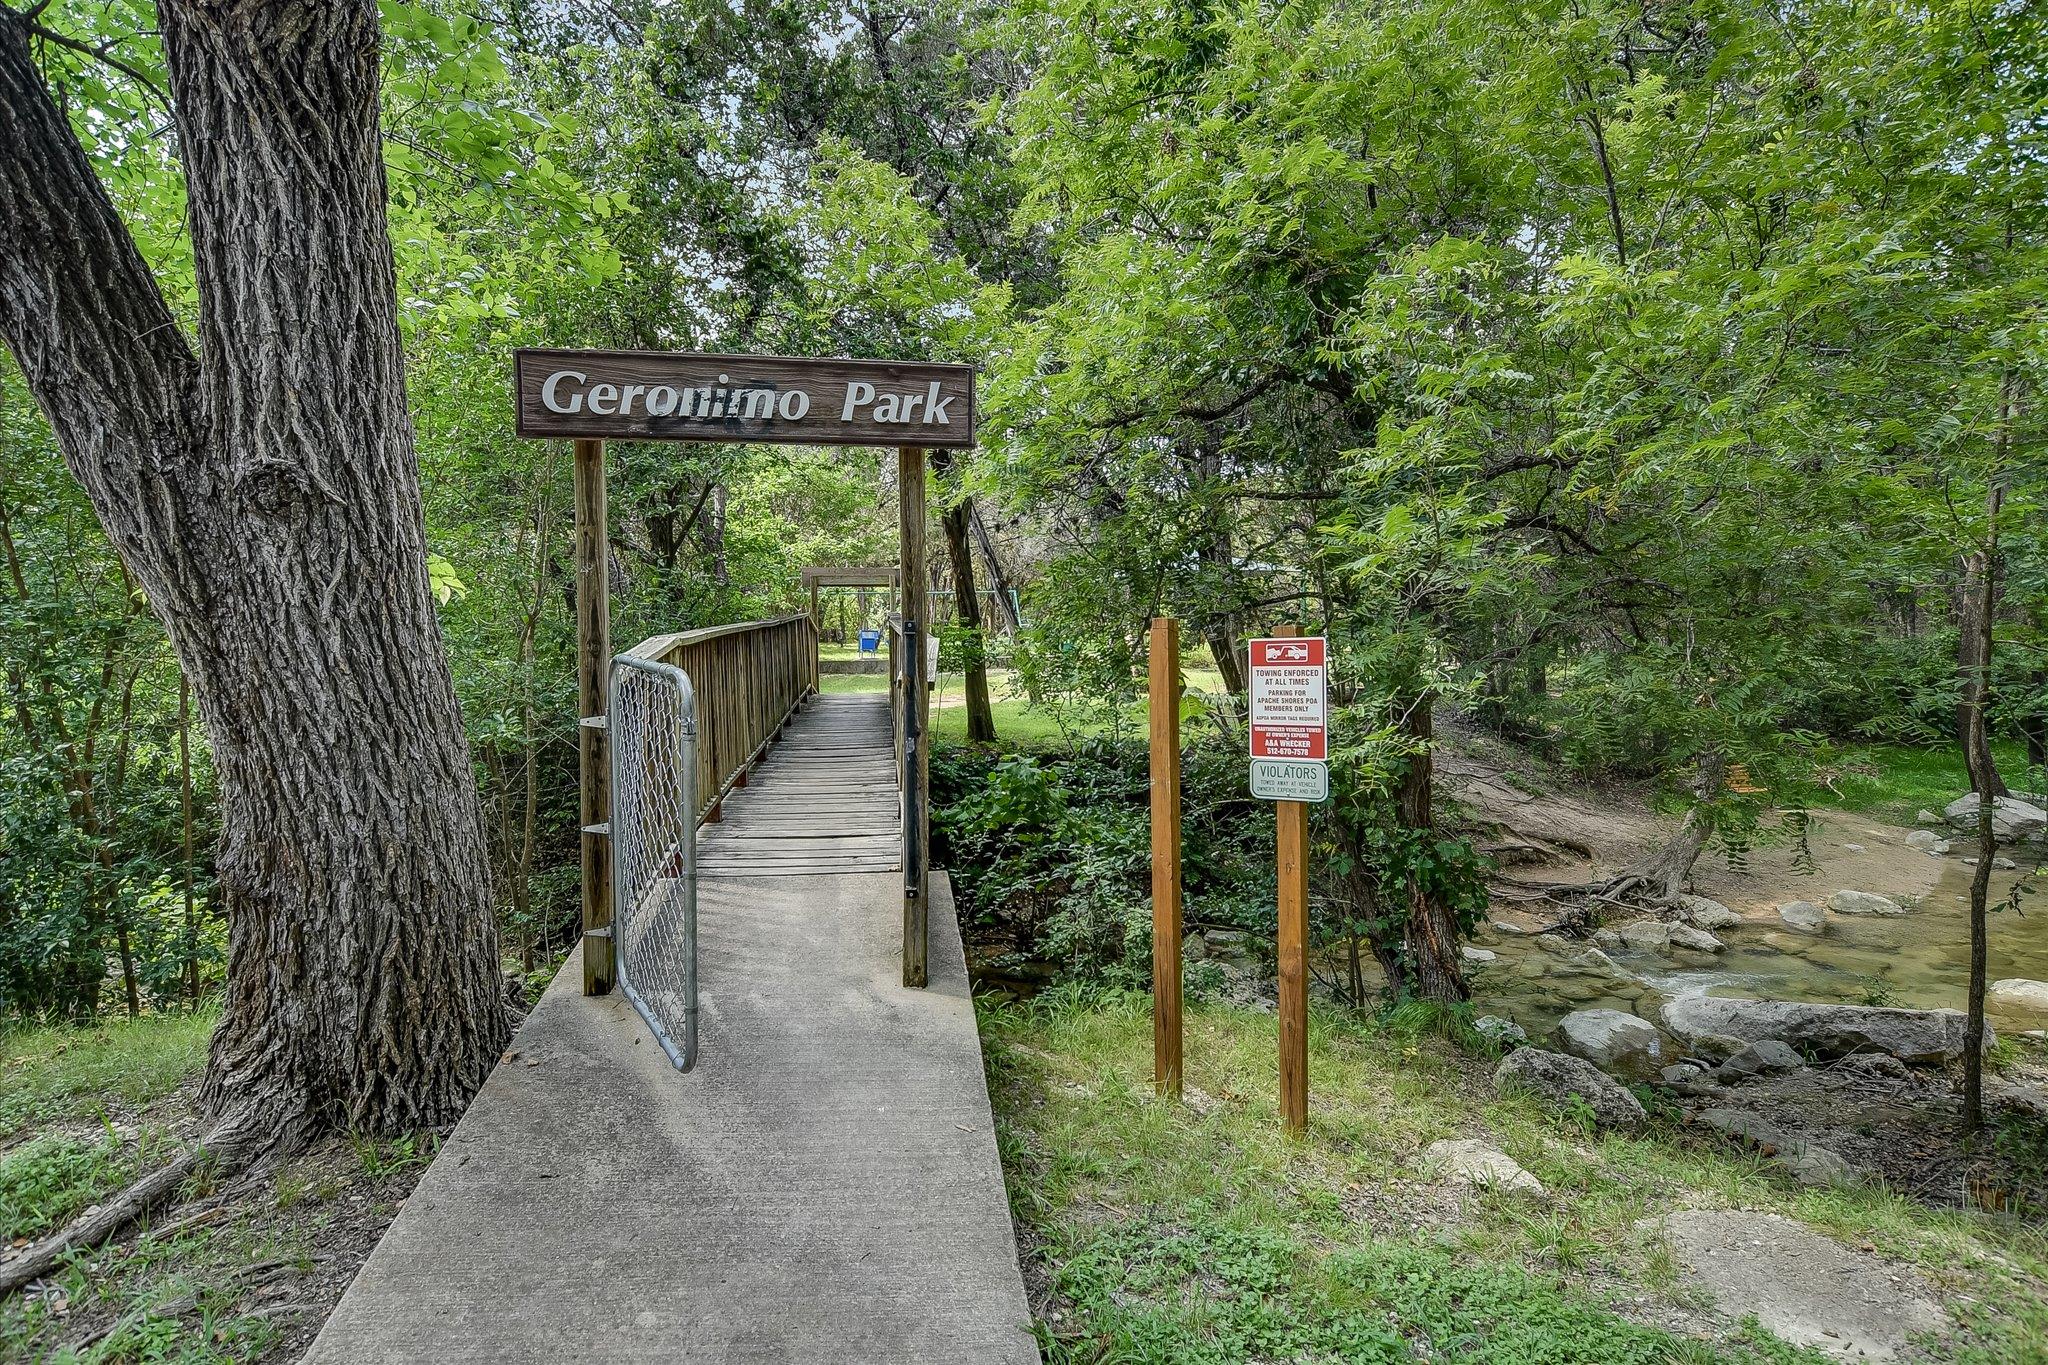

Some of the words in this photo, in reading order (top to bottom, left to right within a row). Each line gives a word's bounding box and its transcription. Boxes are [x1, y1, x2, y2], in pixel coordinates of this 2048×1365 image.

[541, 370, 810, 421] Geronimo
[841, 381, 956, 425] Park
[1260, 766, 1317, 780] VIOLATORS
